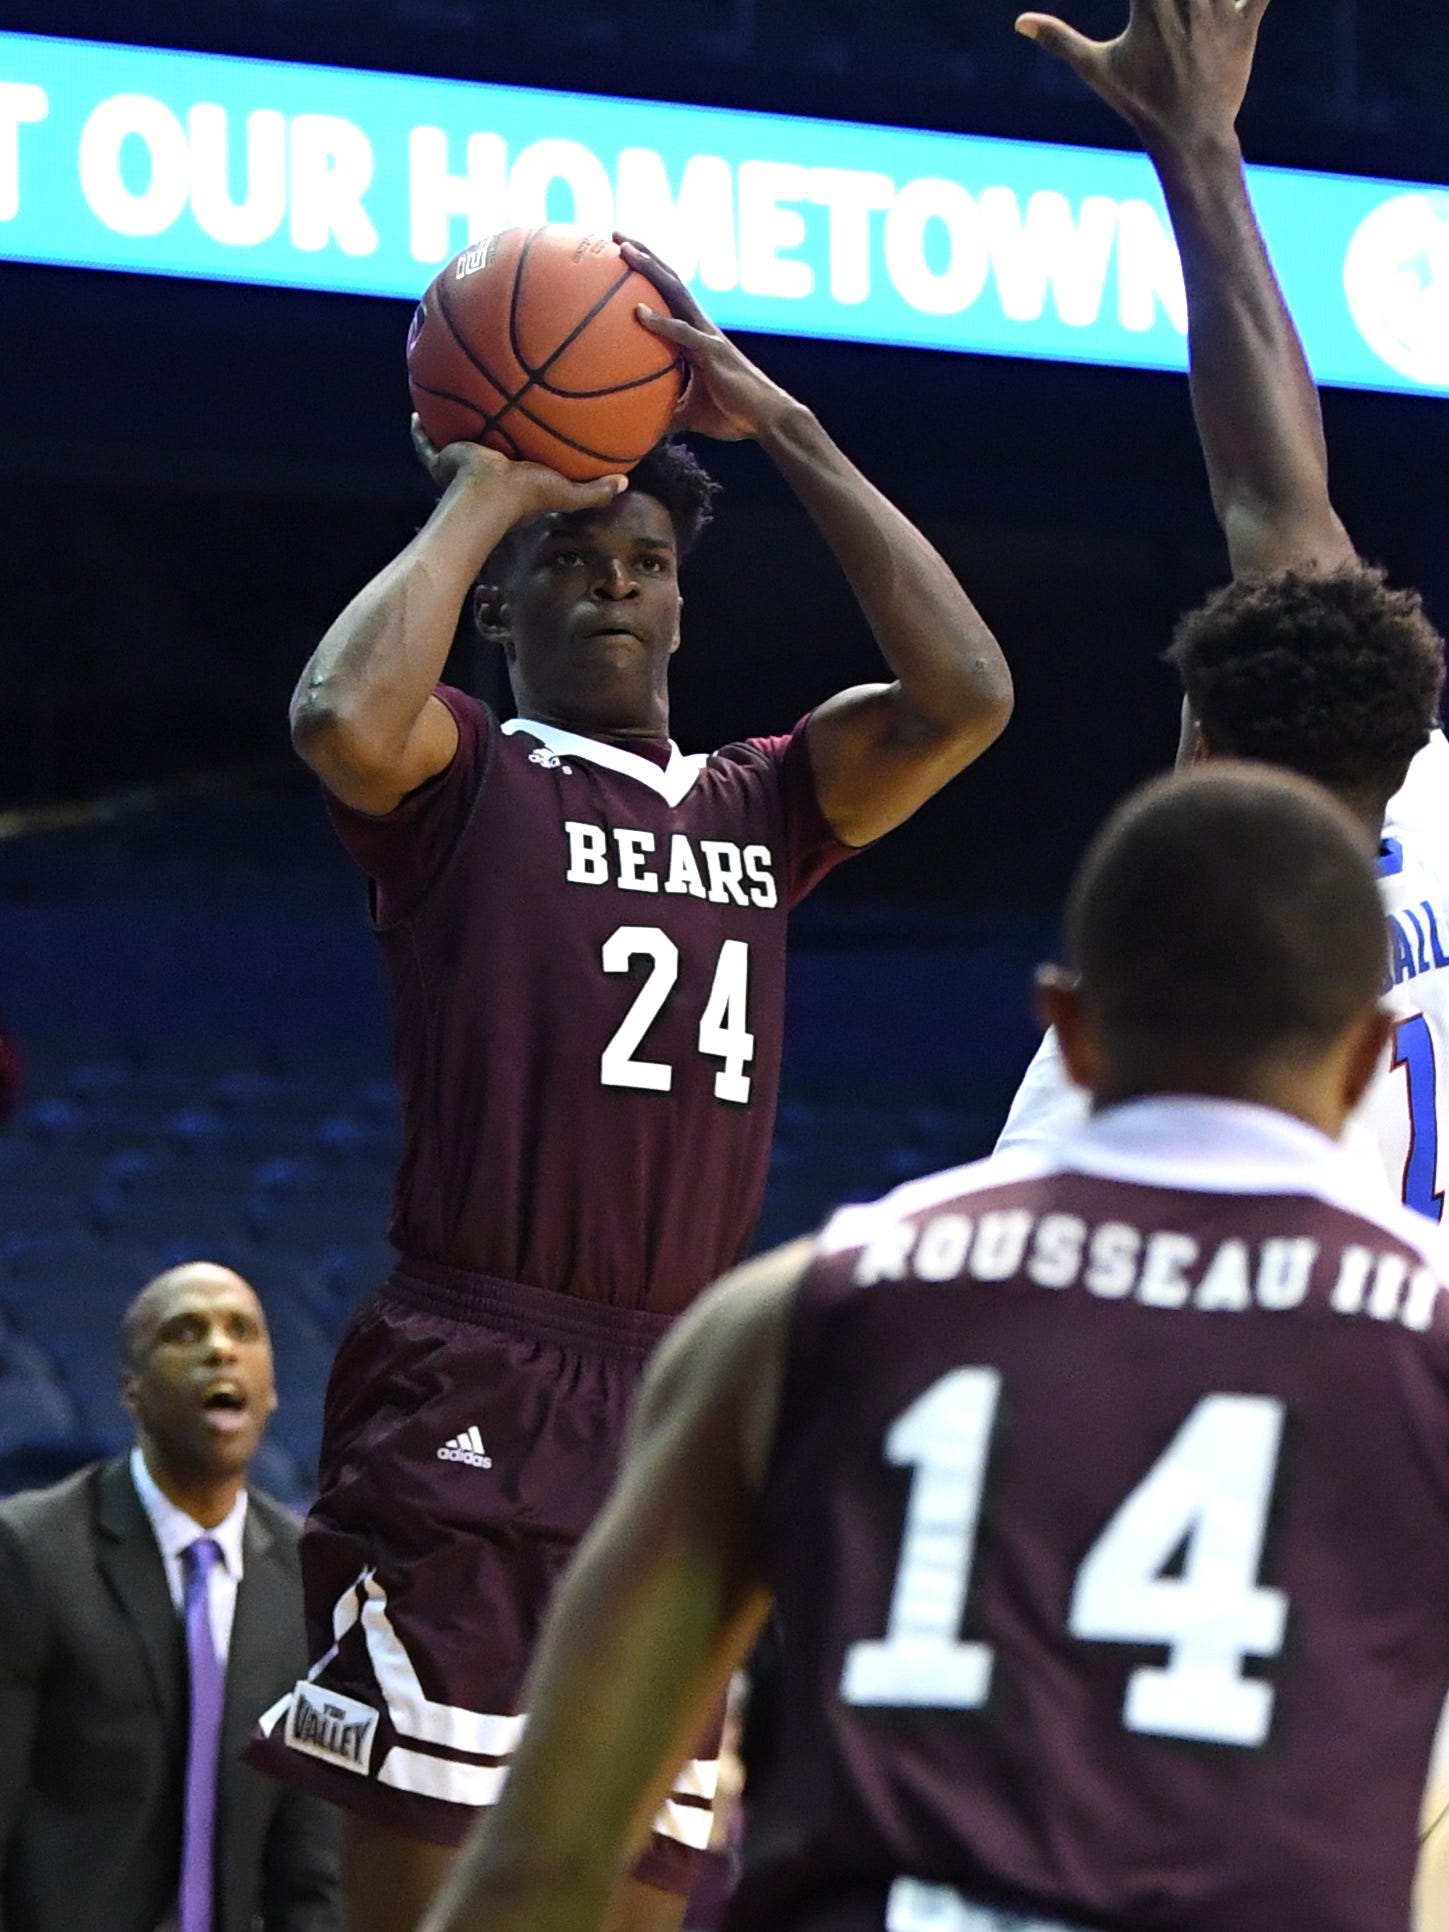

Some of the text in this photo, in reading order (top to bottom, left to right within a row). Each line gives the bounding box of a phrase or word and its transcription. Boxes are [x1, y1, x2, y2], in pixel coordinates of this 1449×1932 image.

[79, 93, 379, 256] OUR
[408, 125, 1189, 335] HOMETOWN
[565, 821, 778, 909] BEARS
[601, 926, 754, 1103] 24
[853, 1209, 1440, 1333] ROUSSEAU III
[437, 1447, 492, 1470] adidas
[840, 1365, 1290, 1748] 14
[293, 1693, 373, 1766] VALLEY
